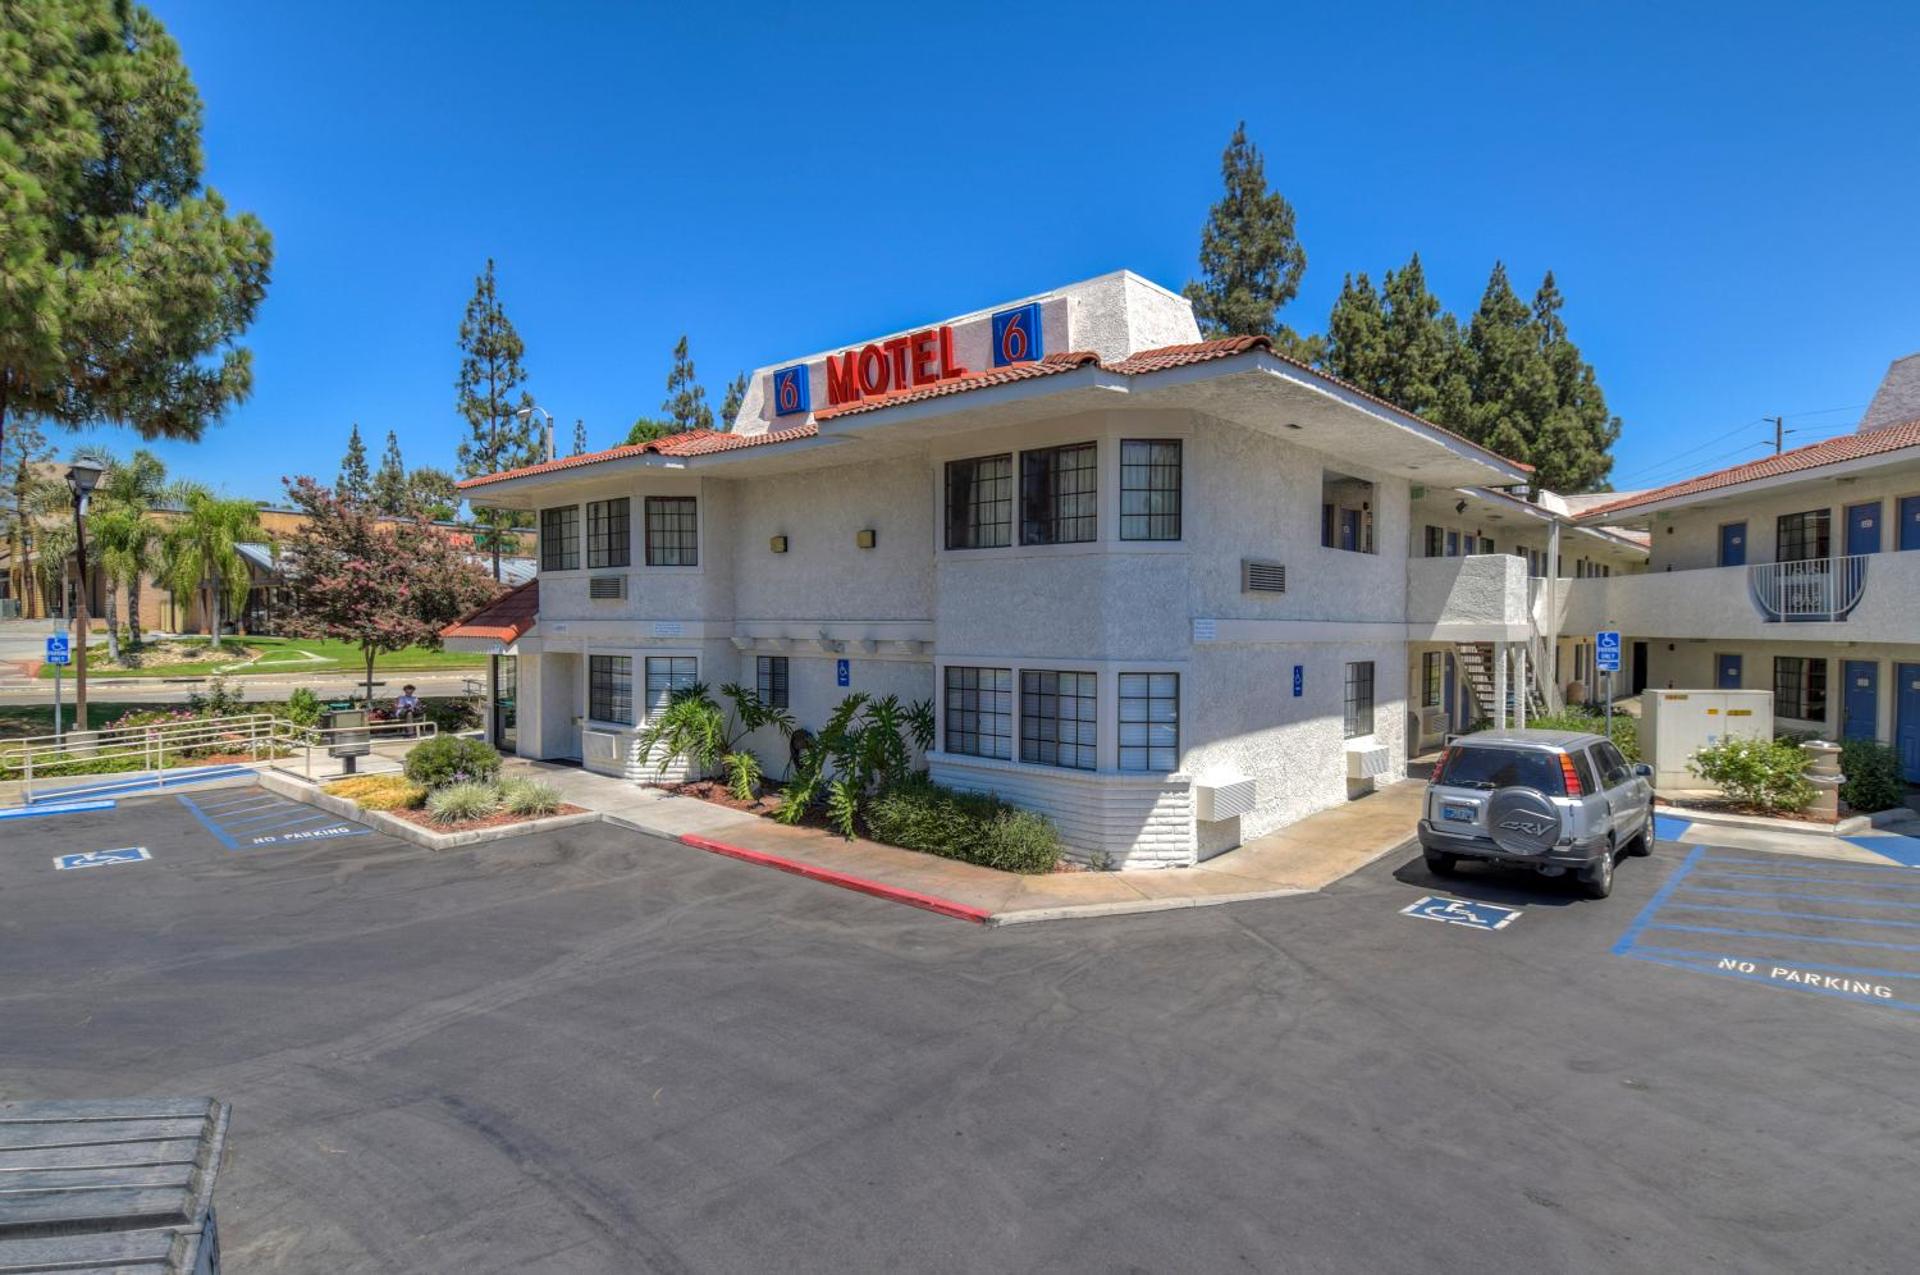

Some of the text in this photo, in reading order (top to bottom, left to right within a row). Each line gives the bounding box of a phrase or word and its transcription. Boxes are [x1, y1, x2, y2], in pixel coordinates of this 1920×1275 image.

[1001, 313, 1028, 360] 6
[826, 326, 967, 405] MOTEL
[779, 372, 799, 411] 6
[253, 826, 350, 844] NO PARKING
[1718, 958, 1893, 998] NO PARKING
